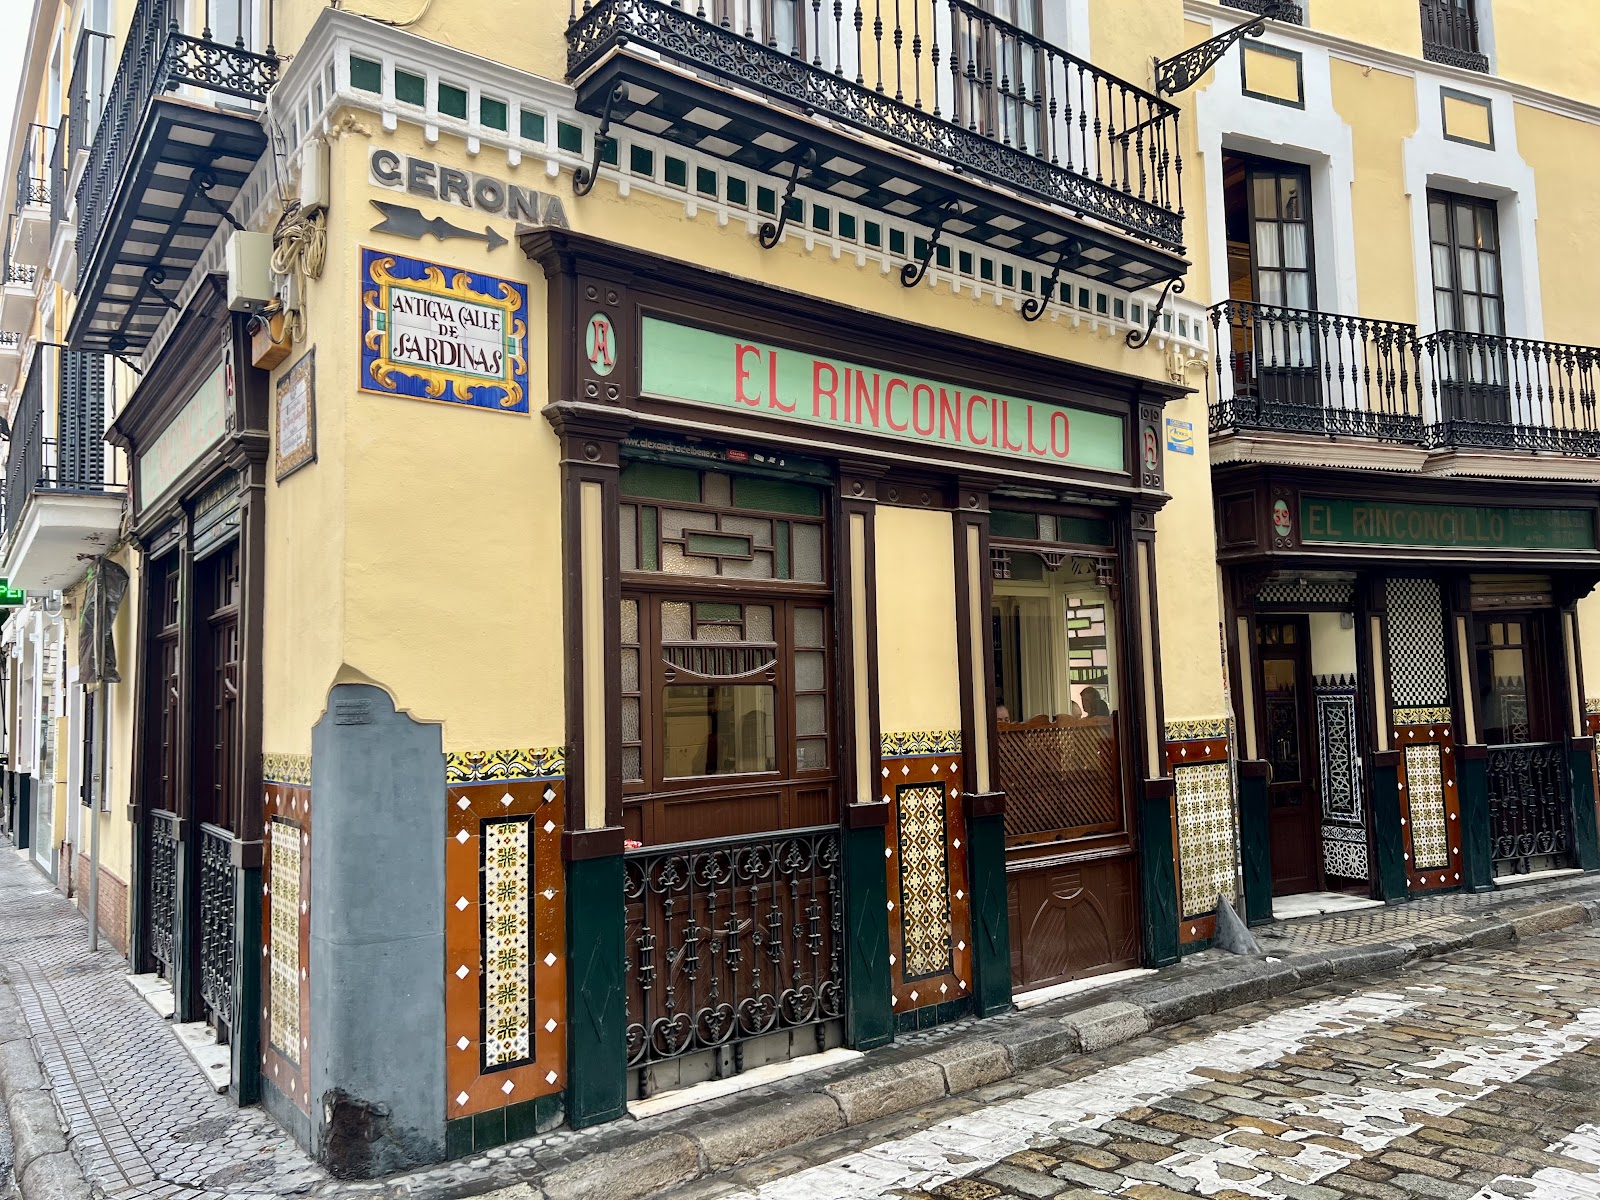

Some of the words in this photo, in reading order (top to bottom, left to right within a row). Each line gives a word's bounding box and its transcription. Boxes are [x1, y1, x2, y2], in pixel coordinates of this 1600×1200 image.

[371, 150, 571, 230] GERONA
[438, 323, 459, 339] DE
[458, 306, 501, 332] CALLE
[393, 332, 502, 374] SARDINAS
[734, 342, 797, 413] EL
[811, 360, 1071, 459] RINCONCILLO
[1144, 432, 1157, 464] R
[1309, 505, 1342, 536] EL
[1353, 507, 1503, 542] RINCONCILLO
